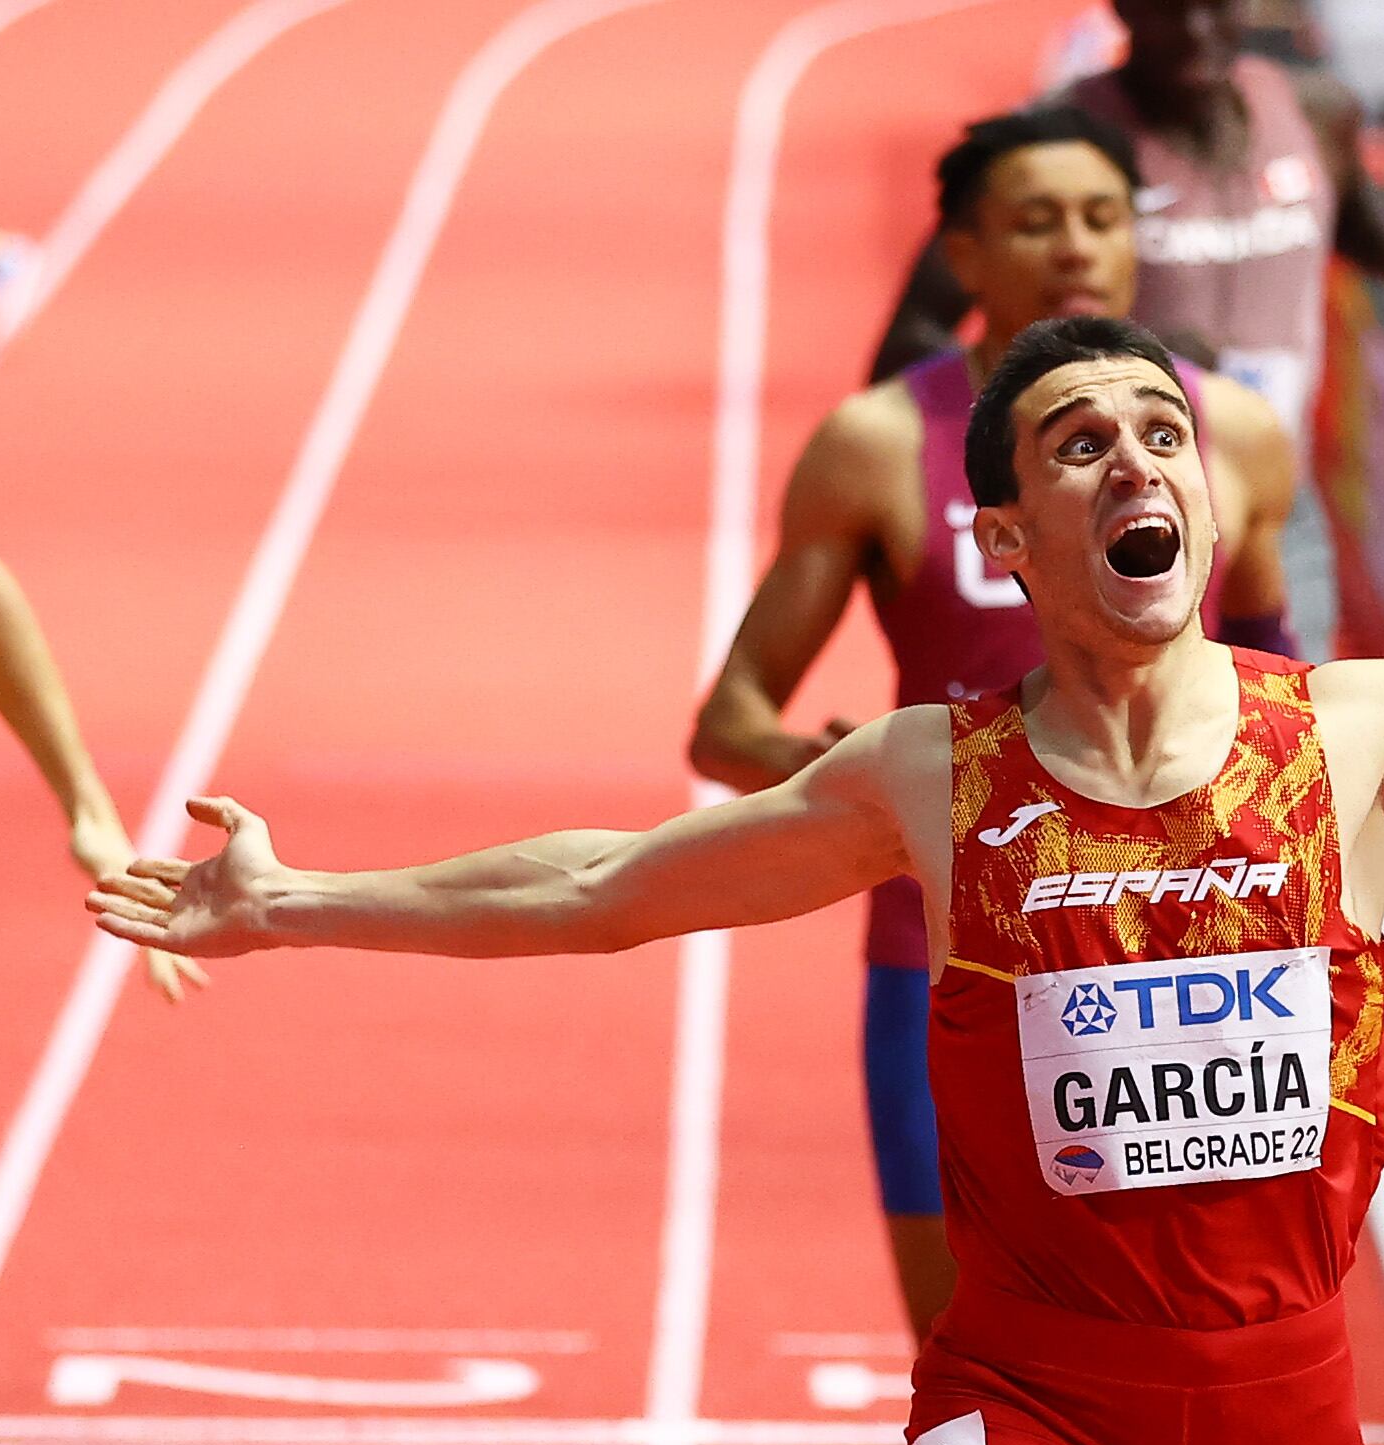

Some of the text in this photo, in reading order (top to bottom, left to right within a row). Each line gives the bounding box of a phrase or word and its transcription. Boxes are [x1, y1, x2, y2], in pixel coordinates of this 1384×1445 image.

[1021, 857, 1290, 914] ESPAÑA
[1113, 965, 1295, 1030] TDK
[1053, 1041, 1311, 1133] GARCÍA
[1124, 1124, 1319, 1177] BELGRADE 22
